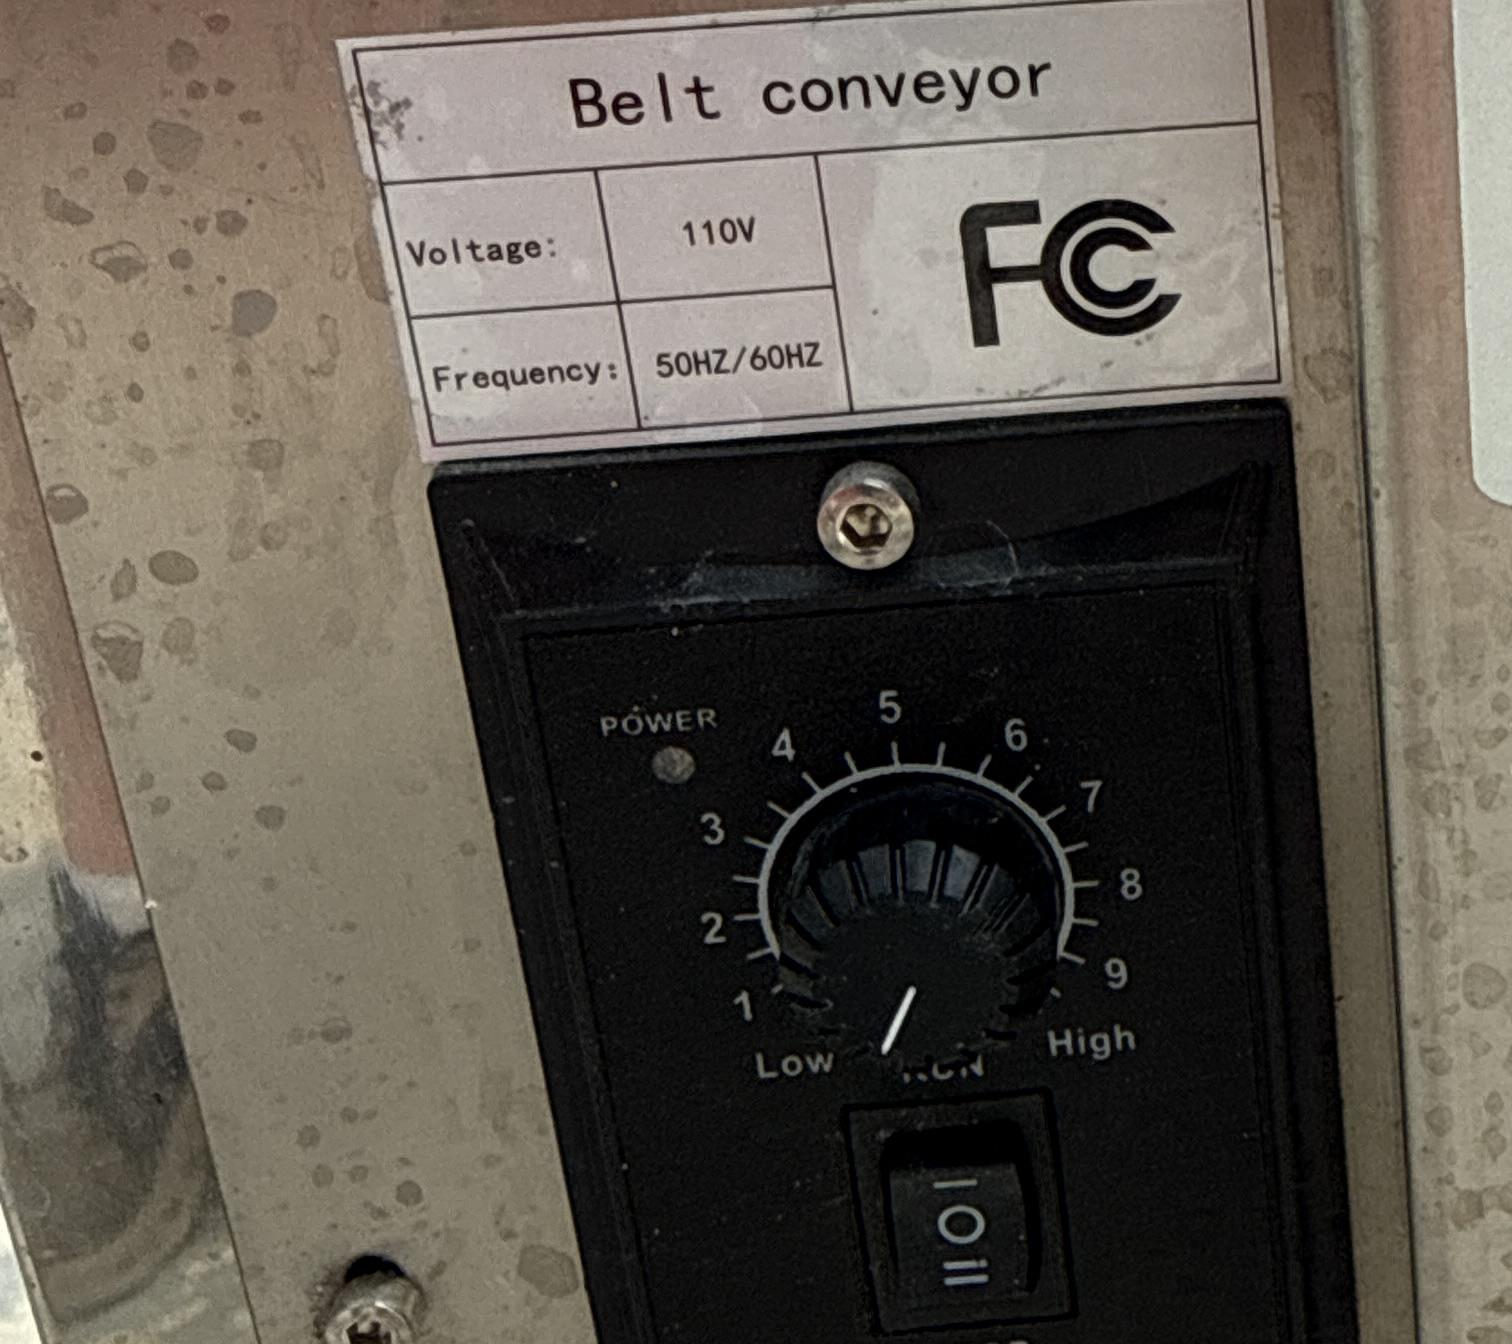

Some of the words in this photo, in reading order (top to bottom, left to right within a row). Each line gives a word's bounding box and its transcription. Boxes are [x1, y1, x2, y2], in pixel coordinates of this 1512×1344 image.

[568, 72, 721, 128] Belt
[763, 62, 1051, 115] conveyor
[683, 216, 755, 246] 110V
[406, 238, 555, 267] Voltage:
[656, 342, 823, 378] 50HZ/60HZ
[433, 363, 617, 392] Frequency:
[601, 709, 716, 736] POWER
[879, 690, 901, 724] 5
[772, 728, 795, 761] 4
[1005, 718, 1027, 751] 6
[1080, 780, 1102, 812] 7
[701, 812, 724, 845] 3
[1120, 868, 1142, 900] 8
[701, 912, 726, 944] 2
[1105, 958, 1127, 989] 9
[734, 991, 752, 1021] 1
[1048, 1024, 1135, 1060] High
[756, 1053, 833, 1079] Low
